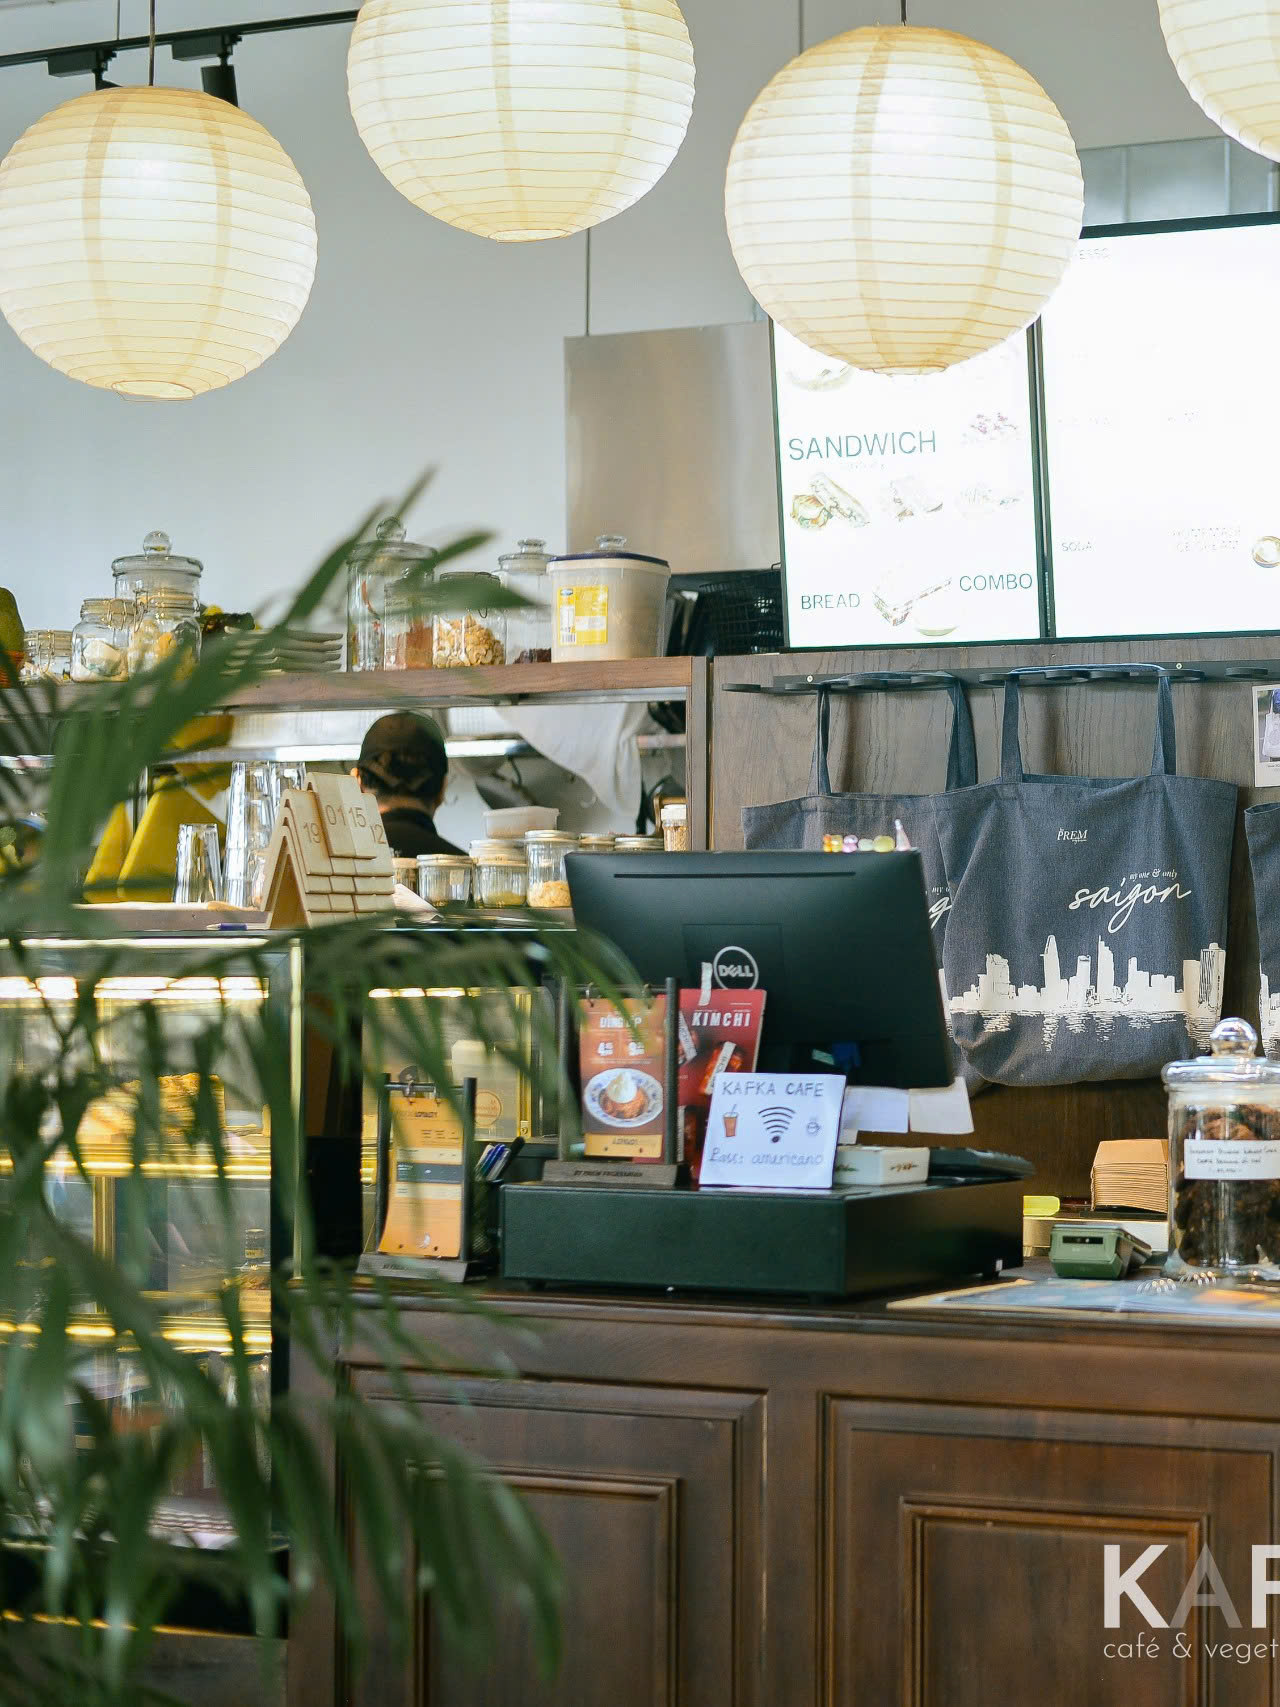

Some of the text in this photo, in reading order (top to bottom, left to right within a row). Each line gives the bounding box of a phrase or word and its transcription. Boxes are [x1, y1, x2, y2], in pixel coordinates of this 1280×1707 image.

[788, 431, 937, 461] SANDWICH
[959, 573, 1034, 592] COMBO
[801, 593, 861, 610] BREAD
[303, 822, 387, 845] 19 12
[1057, 829, 1088, 841] PREM
[1068, 877, 1192, 934] saigon
[718, 964, 754, 978] DELL
[692, 1011, 751, 1027] KIMCHI
[721, 1081, 825, 1098] KAFKA CAFE
